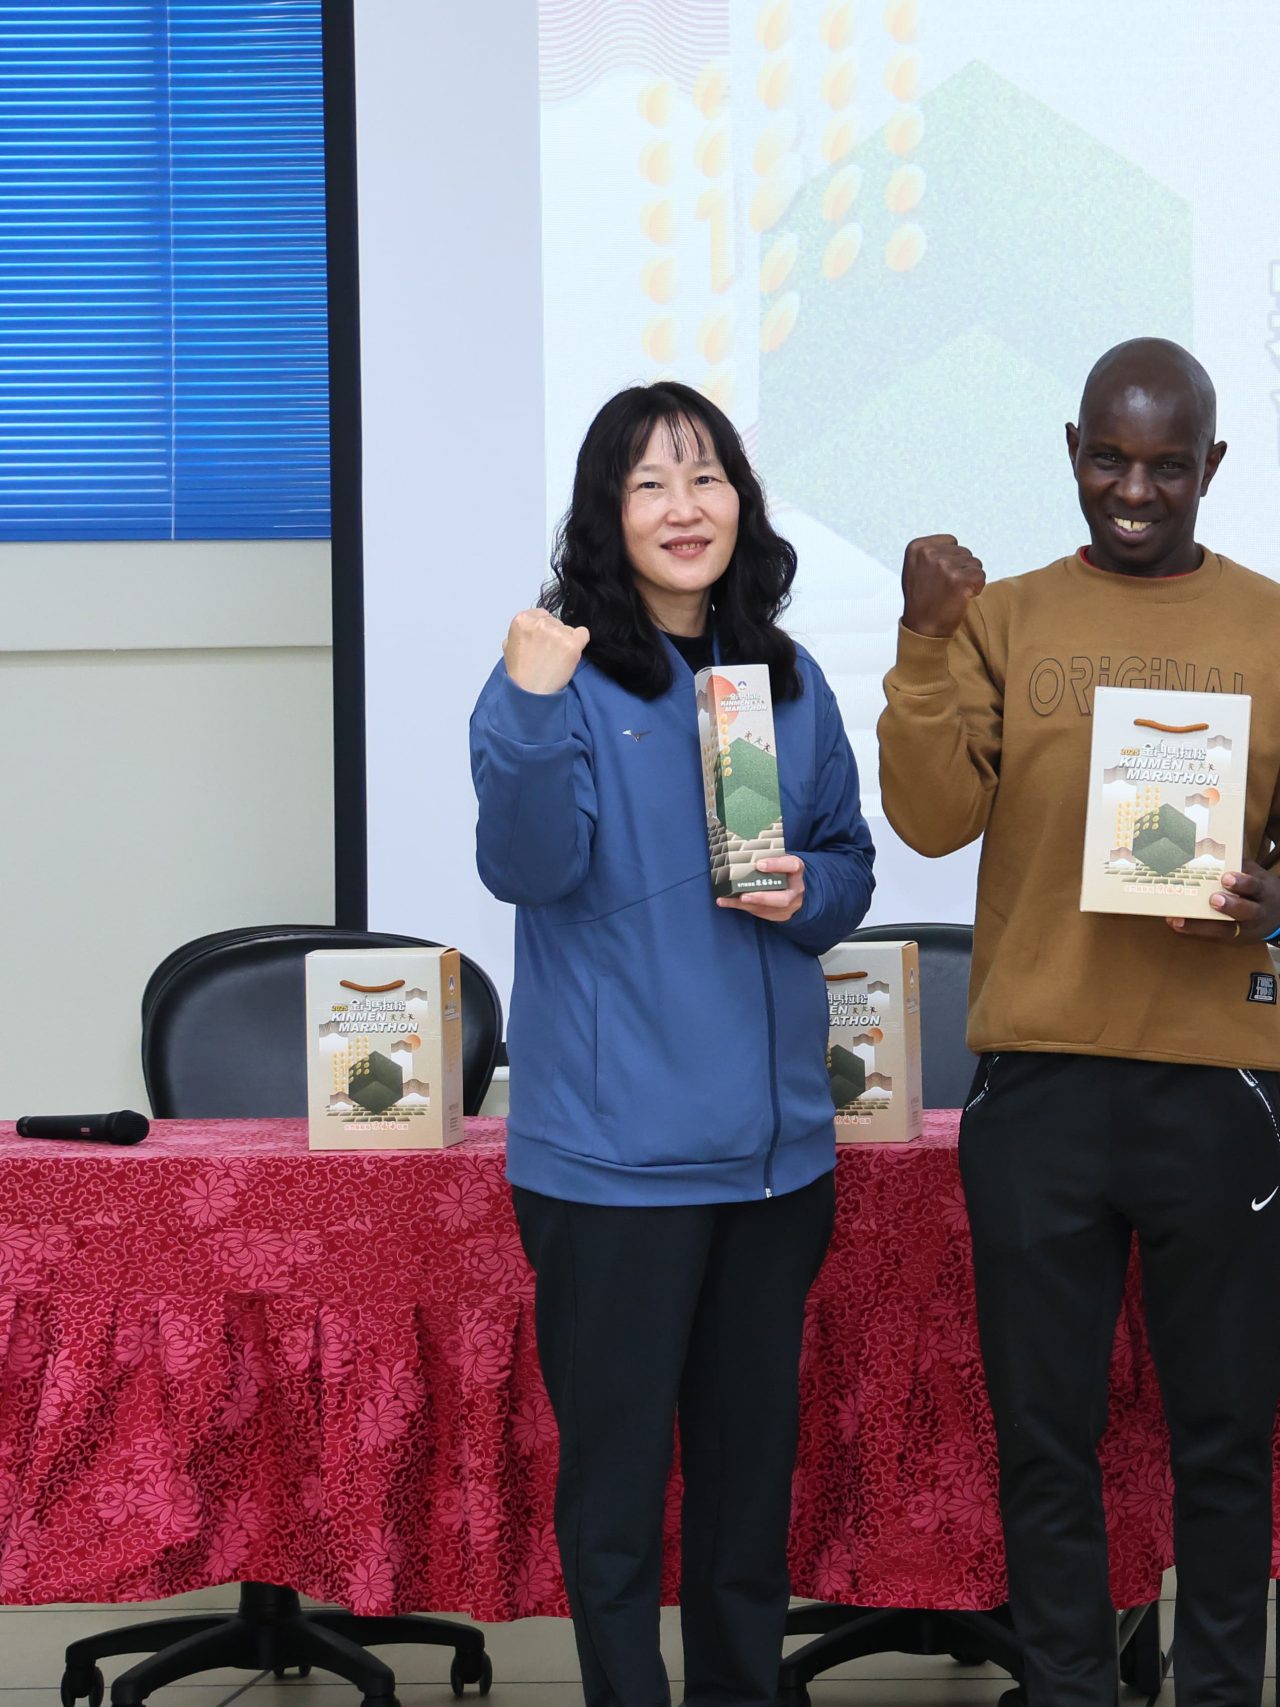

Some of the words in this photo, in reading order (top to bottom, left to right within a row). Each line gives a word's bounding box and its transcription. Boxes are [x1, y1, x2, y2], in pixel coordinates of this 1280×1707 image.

[1118, 756, 1184, 771] KINMEN
[1126, 769, 1219, 786] MARATHON
[331, 1012, 387, 1022] KINMEN
[829, 1015, 881, 1026] ATHON
[338, 1022, 418, 1033] MARATHON
